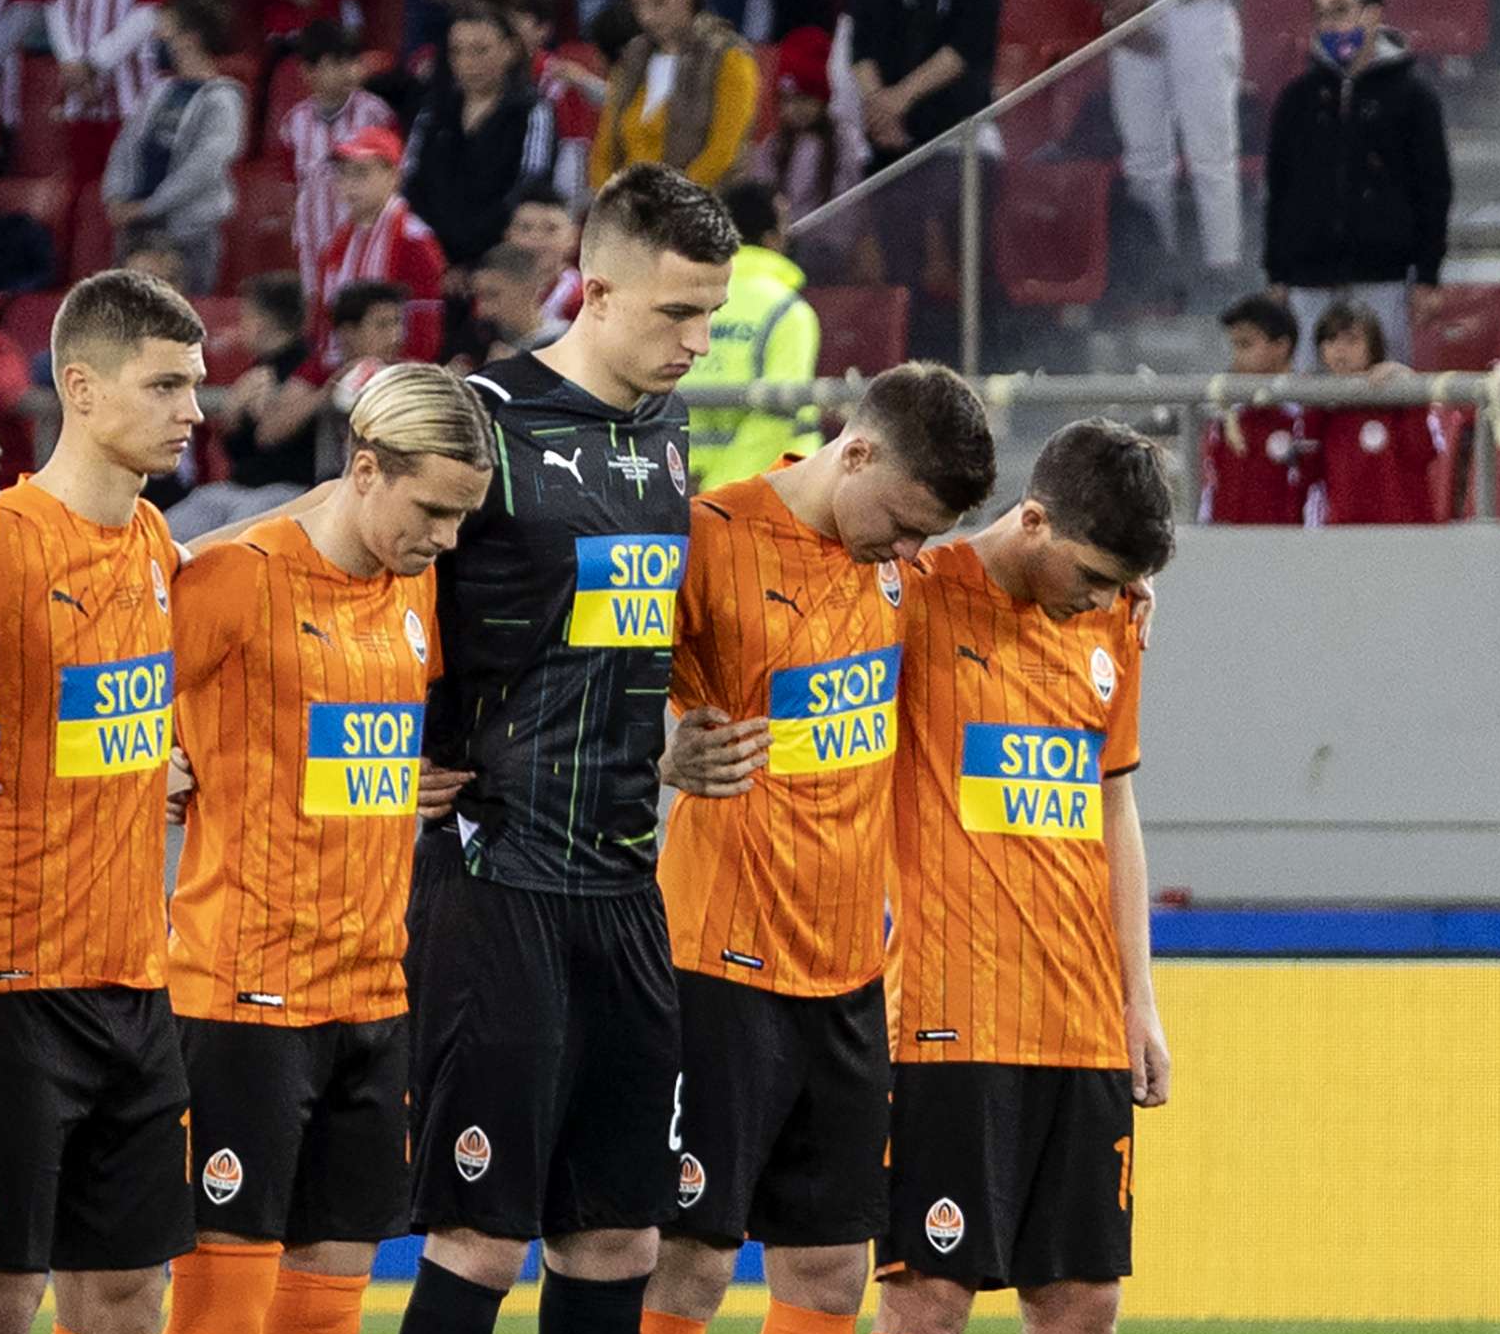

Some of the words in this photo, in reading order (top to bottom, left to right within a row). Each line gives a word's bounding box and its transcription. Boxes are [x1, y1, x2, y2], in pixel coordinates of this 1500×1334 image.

[609, 543, 680, 586] STOP
[611, 597, 672, 636] WA
[95, 663, 167, 715] STOP
[807, 659, 887, 714] STOP
[342, 711, 415, 755] STOP
[811, 712, 887, 762] WAR
[346, 766, 412, 806] WAR
[1002, 786, 1088, 829] WAR
